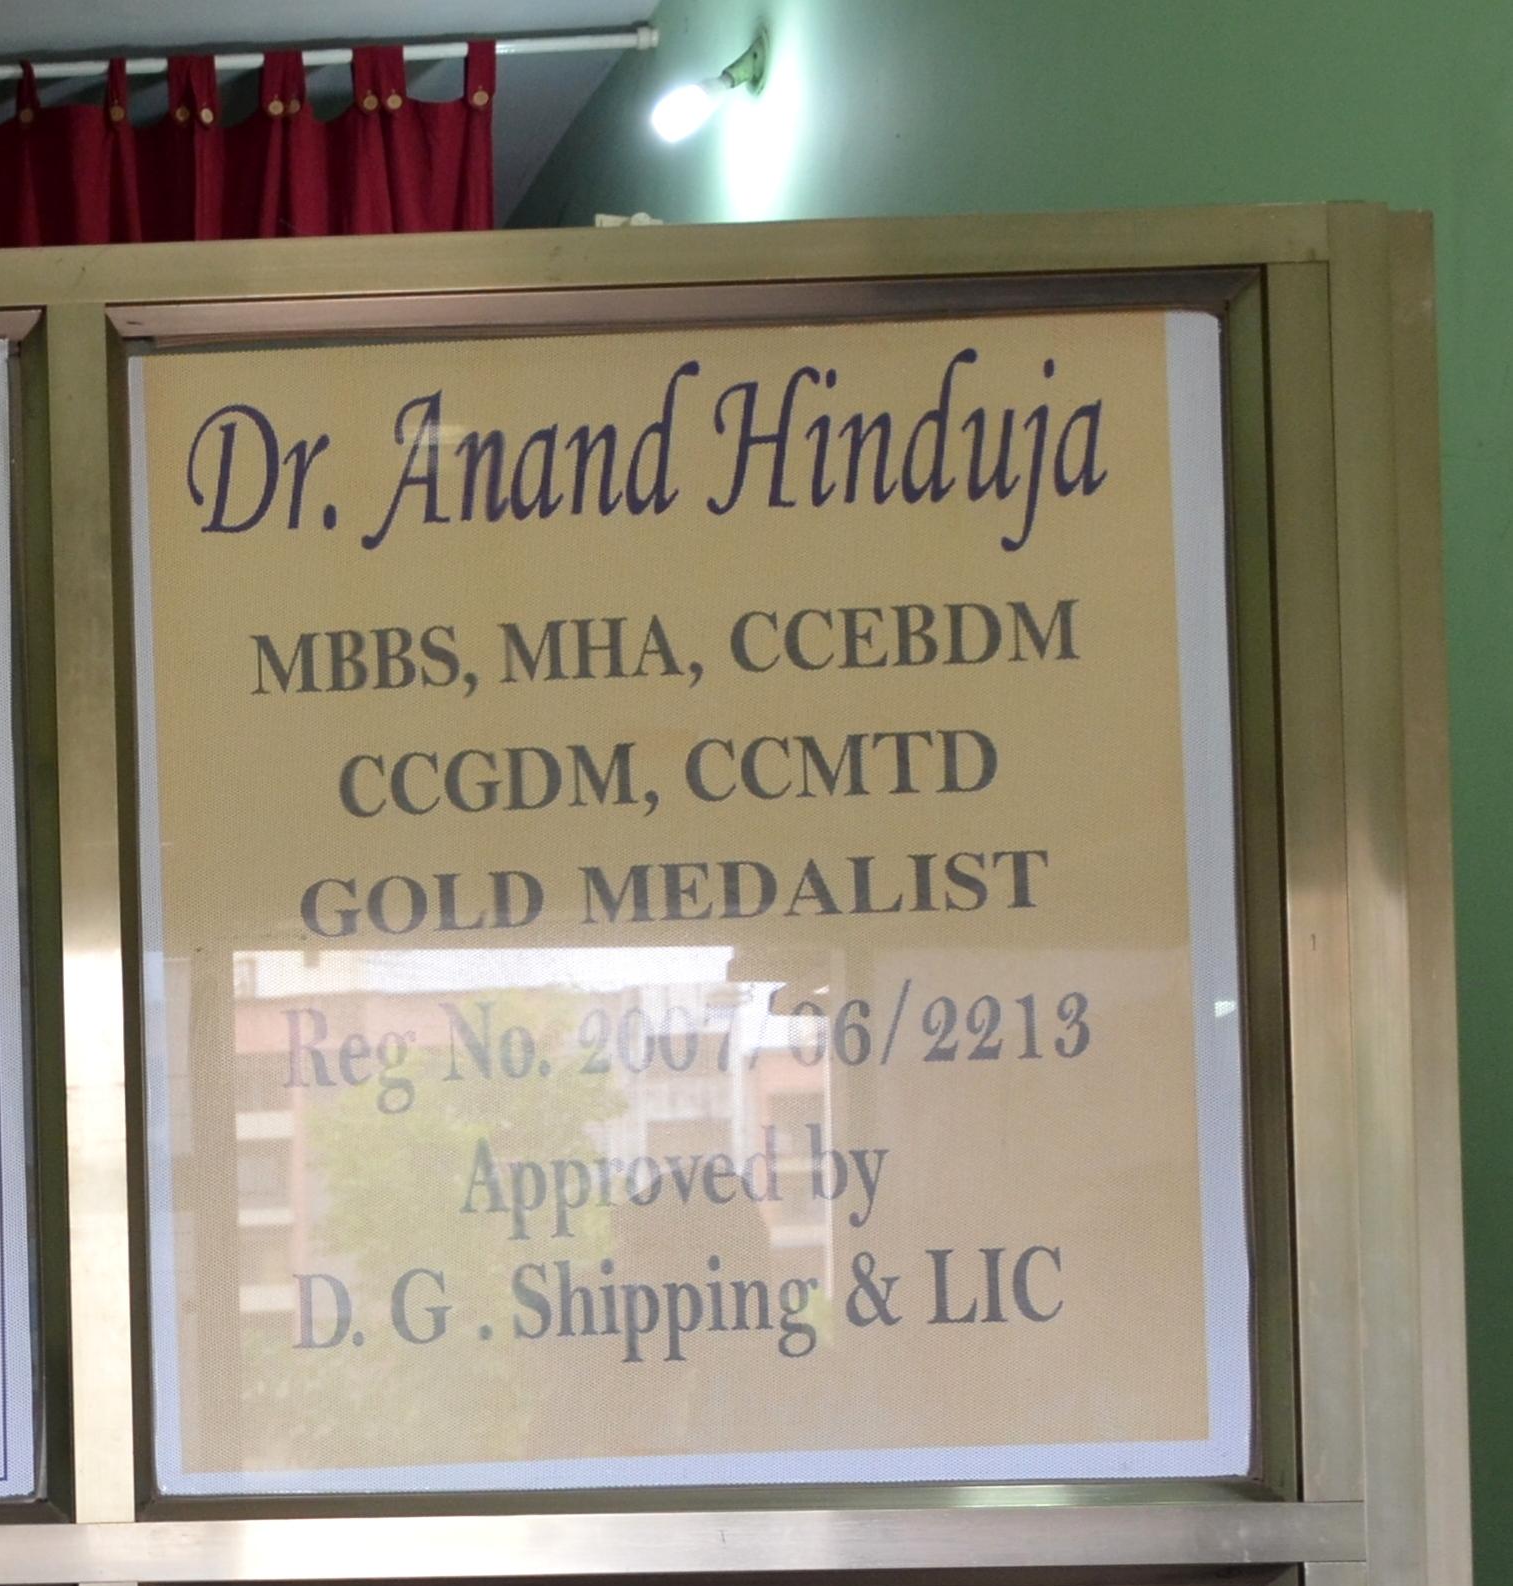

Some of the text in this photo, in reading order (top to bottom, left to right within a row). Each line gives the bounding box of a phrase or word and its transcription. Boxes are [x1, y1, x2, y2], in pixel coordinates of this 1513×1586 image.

[187, 349, 1107, 552] Dr. Anand Hinduja
[251, 599, 1080, 696] MBBS, MHA, CCEBDM
[338, 729, 997, 819] CCGDM, CCMTD
[299, 850, 1049, 938] GOLD MEDALIST
[283, 979, 1092, 1115] Reg No. 2007/06/2213
[459, 1123, 889, 1241] Approved by
[293, 1273, 365, 1350] D.
[510, 1255, 820, 1363] Shipping
[845, 1255, 901, 1327] &
[926, 1246, 1064, 1327] LIC
